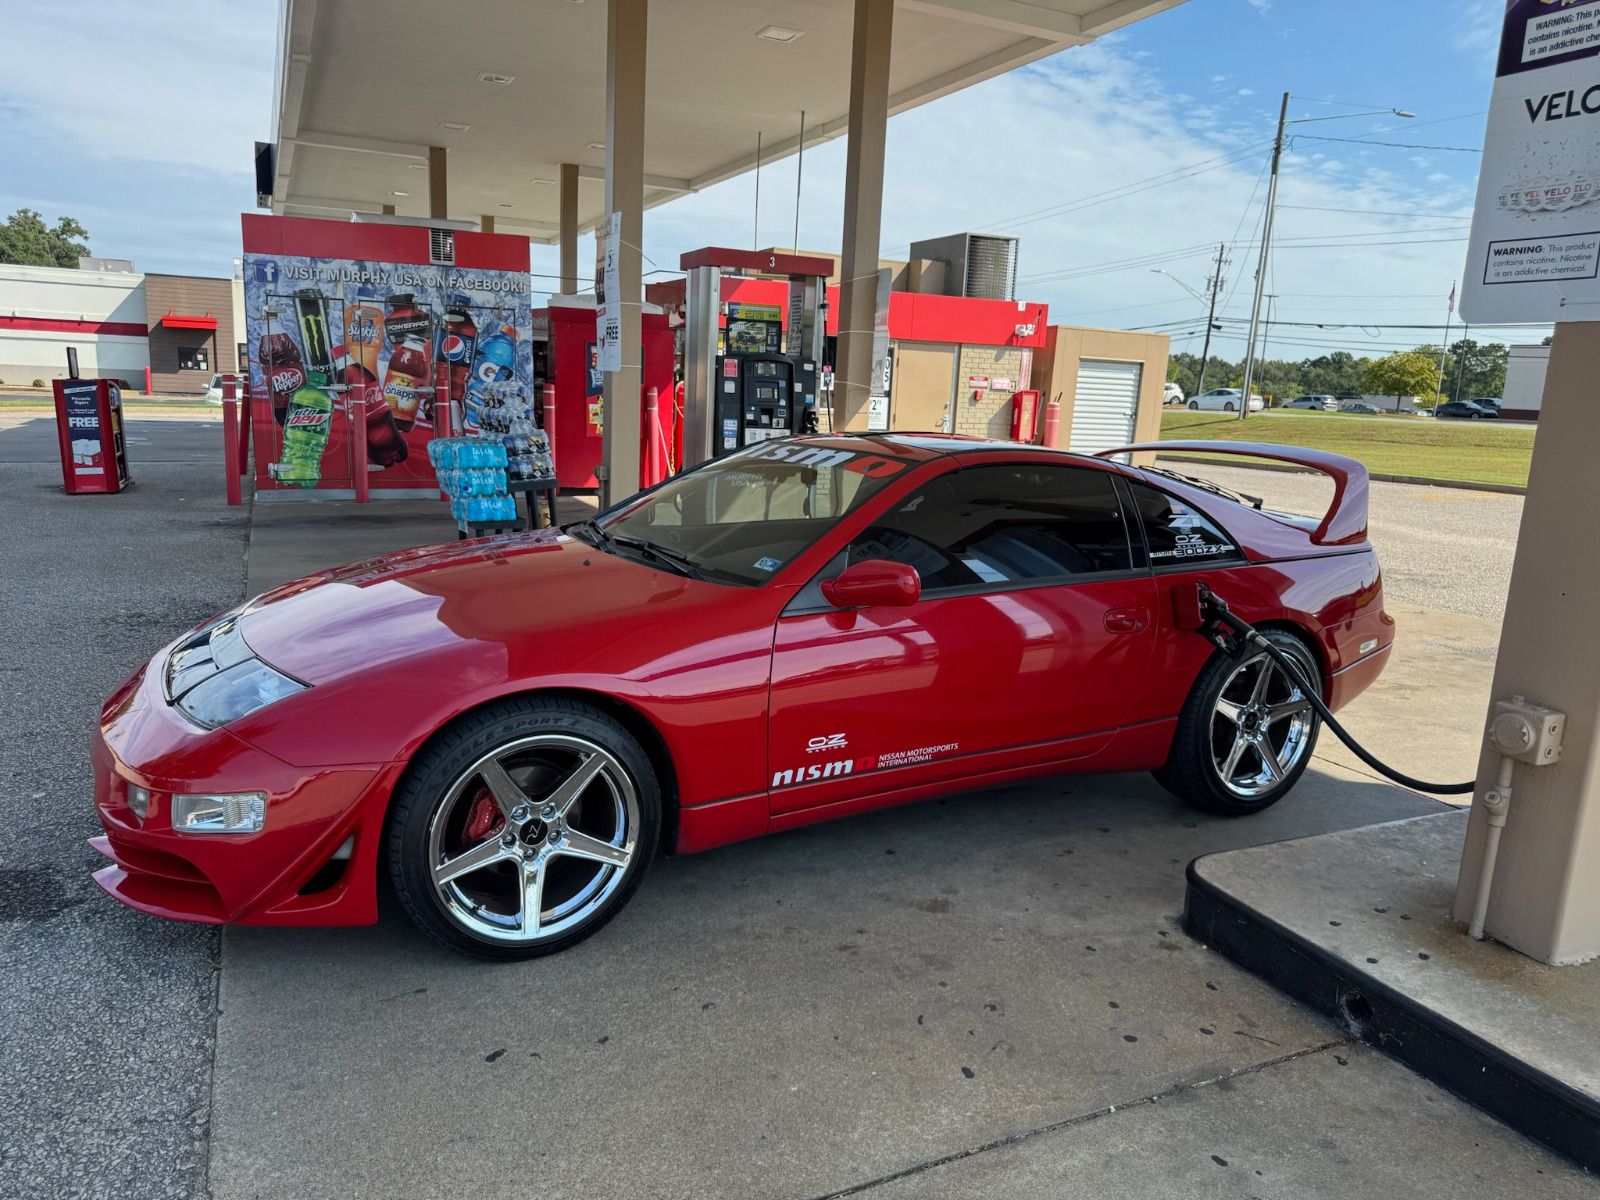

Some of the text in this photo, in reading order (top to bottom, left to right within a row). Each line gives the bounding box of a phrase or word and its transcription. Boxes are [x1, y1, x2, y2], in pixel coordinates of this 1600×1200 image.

[1535, 14, 1574, 30] WARNING:
[1576, 10, 1592, 20] This
[1528, 31, 1560, 44] contains
[1562, 23, 1595, 37] nicotine.
[1530, 48, 1536, 56] is
[1538, 46, 1547, 54] an
[1549, 37, 1584, 51] addictive
[1543, 186, 1572, 196] VELO
[1493, 242, 1596, 256] WARNING: This product
[769, 256, 776, 268] 3
[1493, 254, 1592, 267] contains nicotine. Nicotine
[1494, 269, 1500, 277] is
[1514, 267, 1548, 276] addictive
[1551, 263, 1586, 273] chemical.
[285, 266, 525, 293] VISIT MURPHY USA ON FACEBOOK!
[606, 325, 618, 340] FREE
[464, 339, 472, 364] pepsi
[271, 374, 301, 393] Pepper
[279, 371, 292, 381] Dr
[69, 417, 99, 427] FREE
[1173, 544, 1226, 558] 300ZX
[878, 743, 959, 762] NISSAN MOTORSPORTS
[877, 754, 933, 769] INTERNATIONAL
[771, 755, 876, 787] nismo
